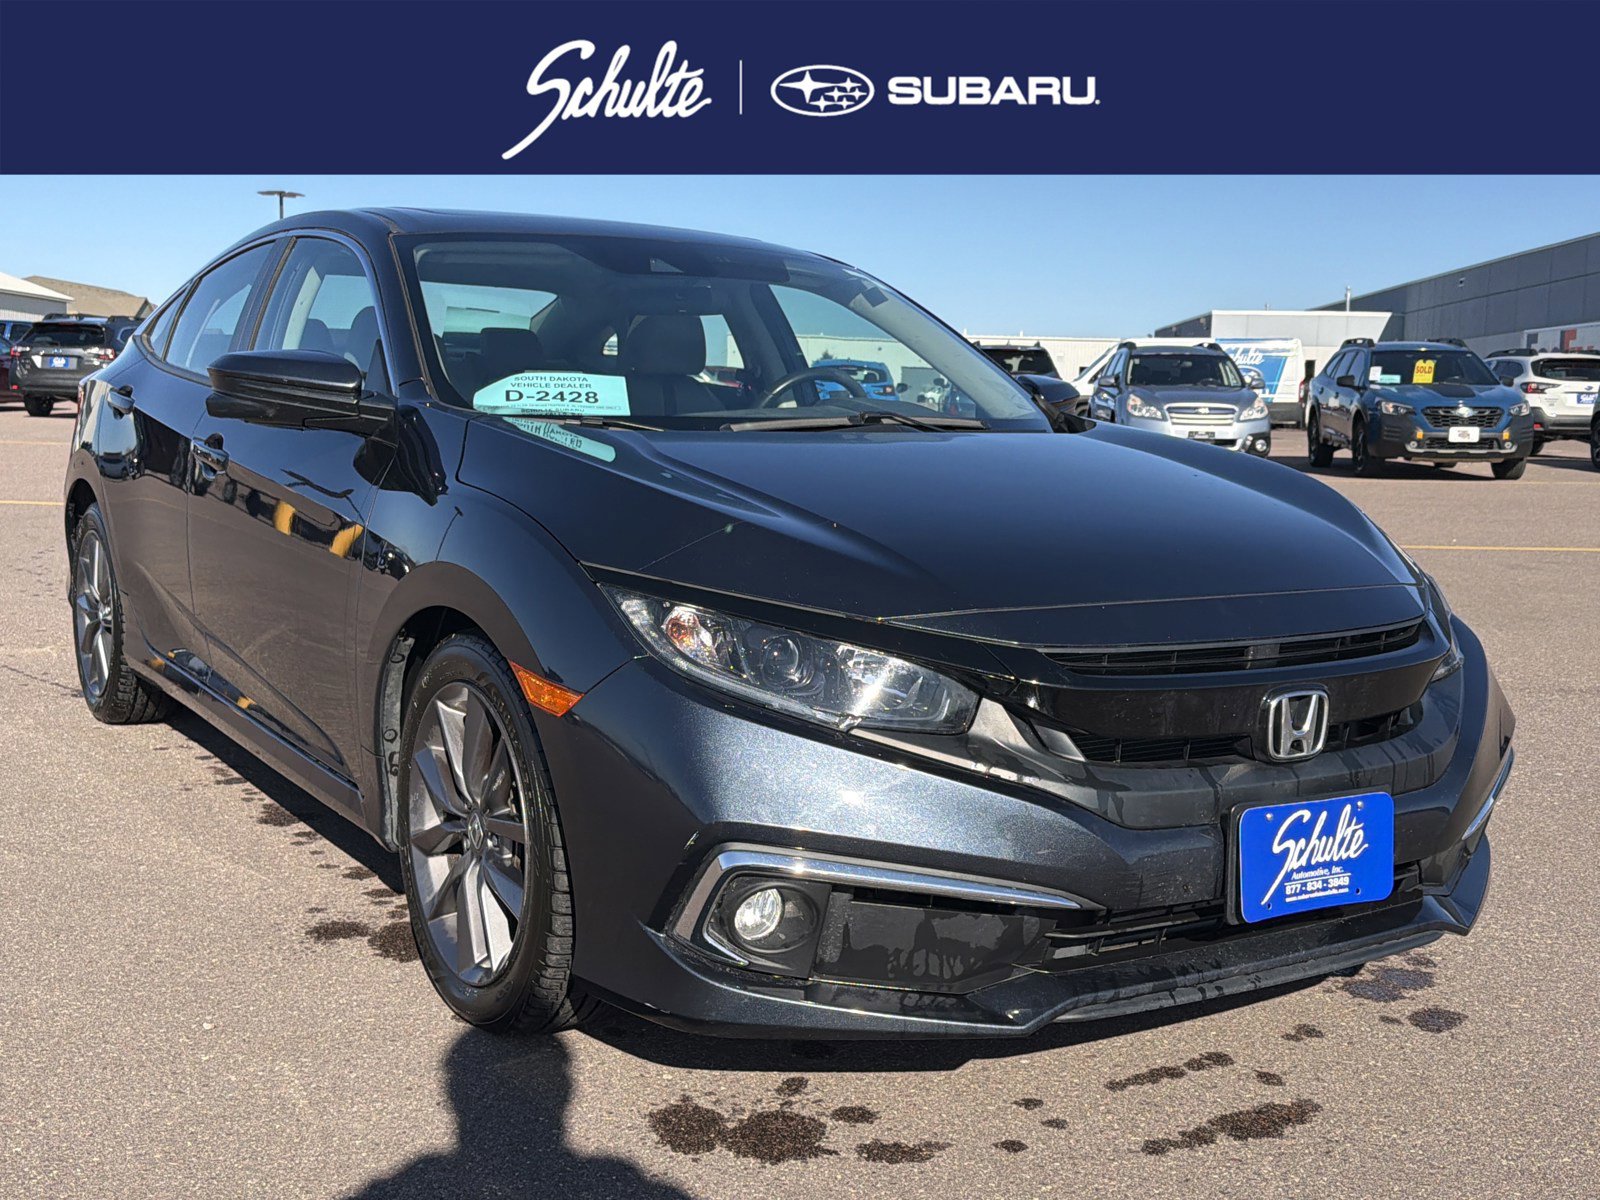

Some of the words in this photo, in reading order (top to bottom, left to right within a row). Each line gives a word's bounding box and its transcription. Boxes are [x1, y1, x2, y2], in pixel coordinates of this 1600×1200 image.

[1415, 365, 1433, 374] SOLD
[505, 390, 599, 404] D-2428
[1260, 804, 1368, 905] Schulte
